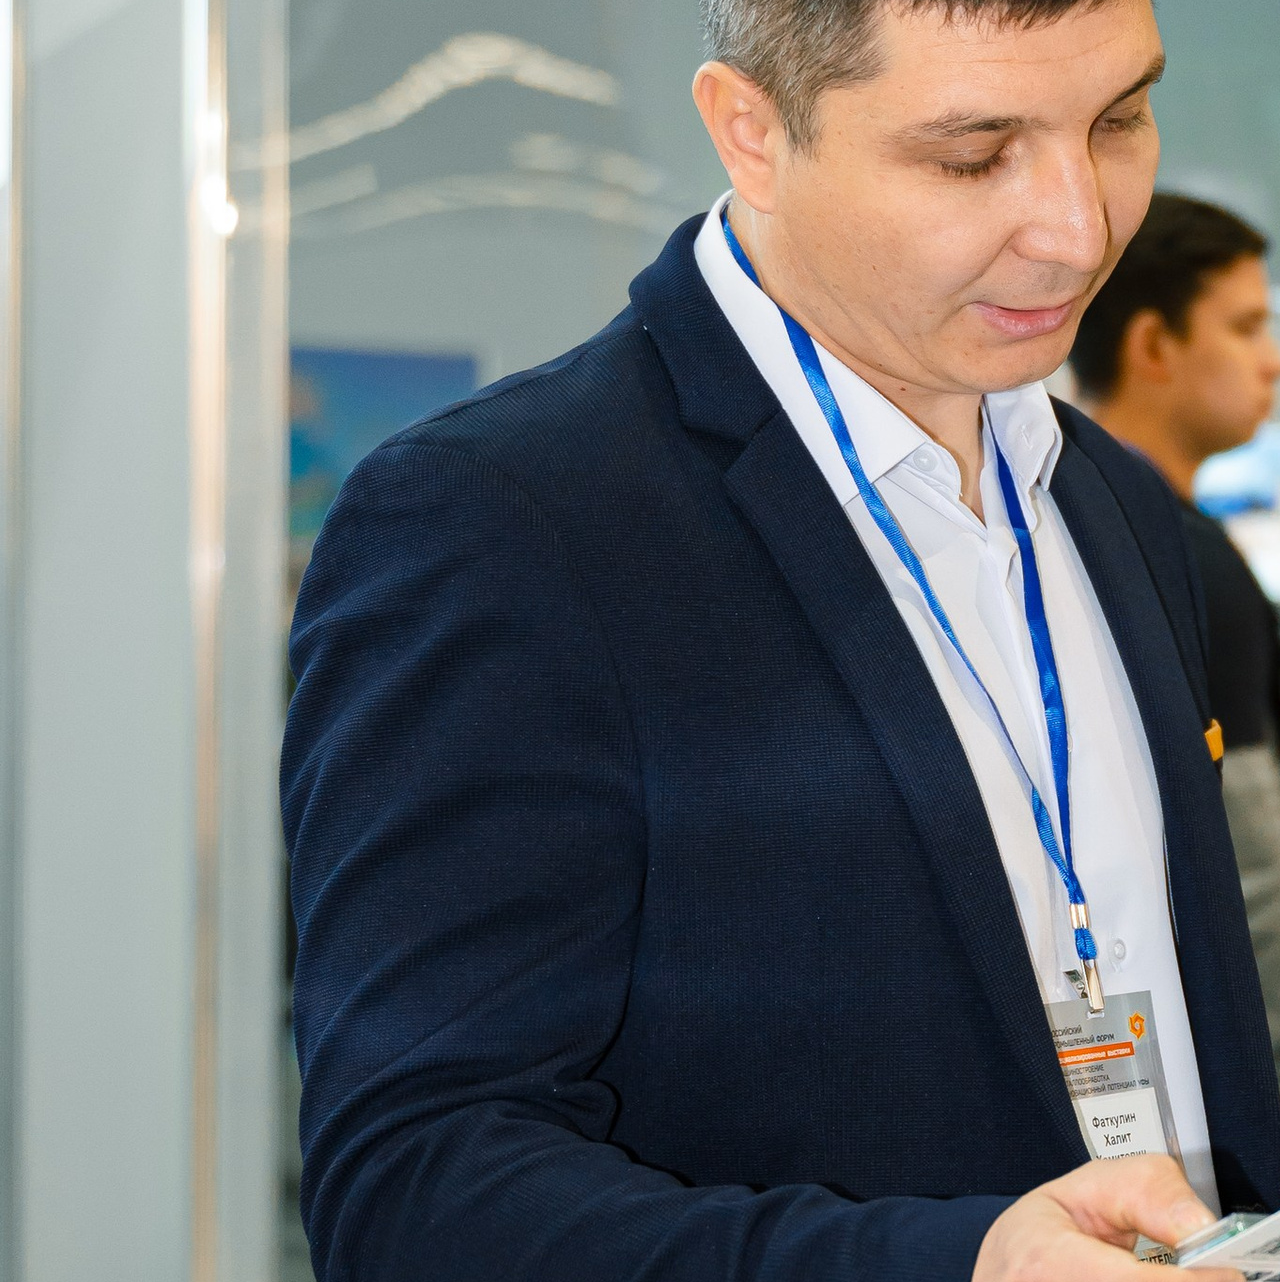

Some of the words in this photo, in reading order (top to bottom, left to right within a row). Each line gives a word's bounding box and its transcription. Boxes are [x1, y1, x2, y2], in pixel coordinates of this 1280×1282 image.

[1052, 1025, 1082, 1037] ОССИЙСКИЙ
[1096, 1033, 1115, 1043] ФОРУМ
[1064, 1064, 1105, 1076] ШИНОСТРОЕНИЕ
[1092, 1113, 1136, 1128] Фаткулин
[1103, 1132, 1131, 1147] Халит
